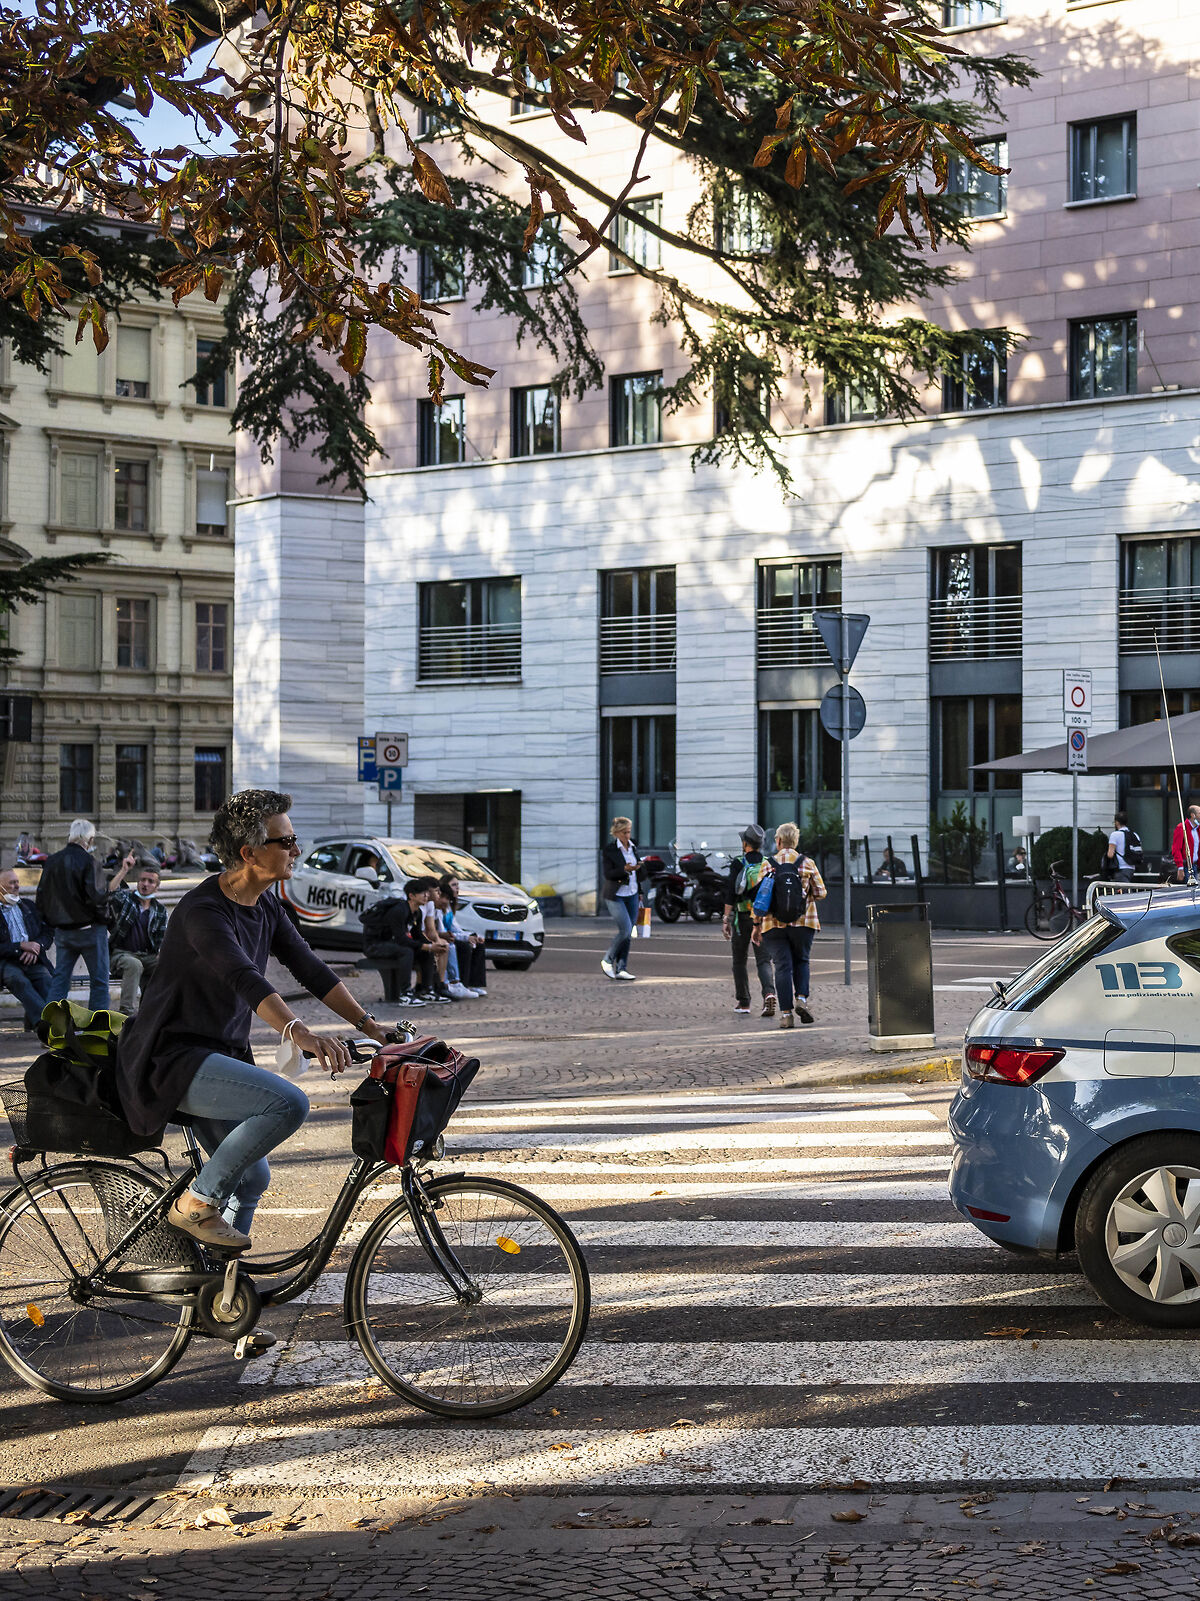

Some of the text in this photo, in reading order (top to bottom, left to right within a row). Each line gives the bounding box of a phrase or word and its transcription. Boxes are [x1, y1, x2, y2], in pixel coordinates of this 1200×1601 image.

[384, 769, 397, 788] P
[307, 884, 366, 912] HASLACH
[1095, 962, 1183, 990] 113
